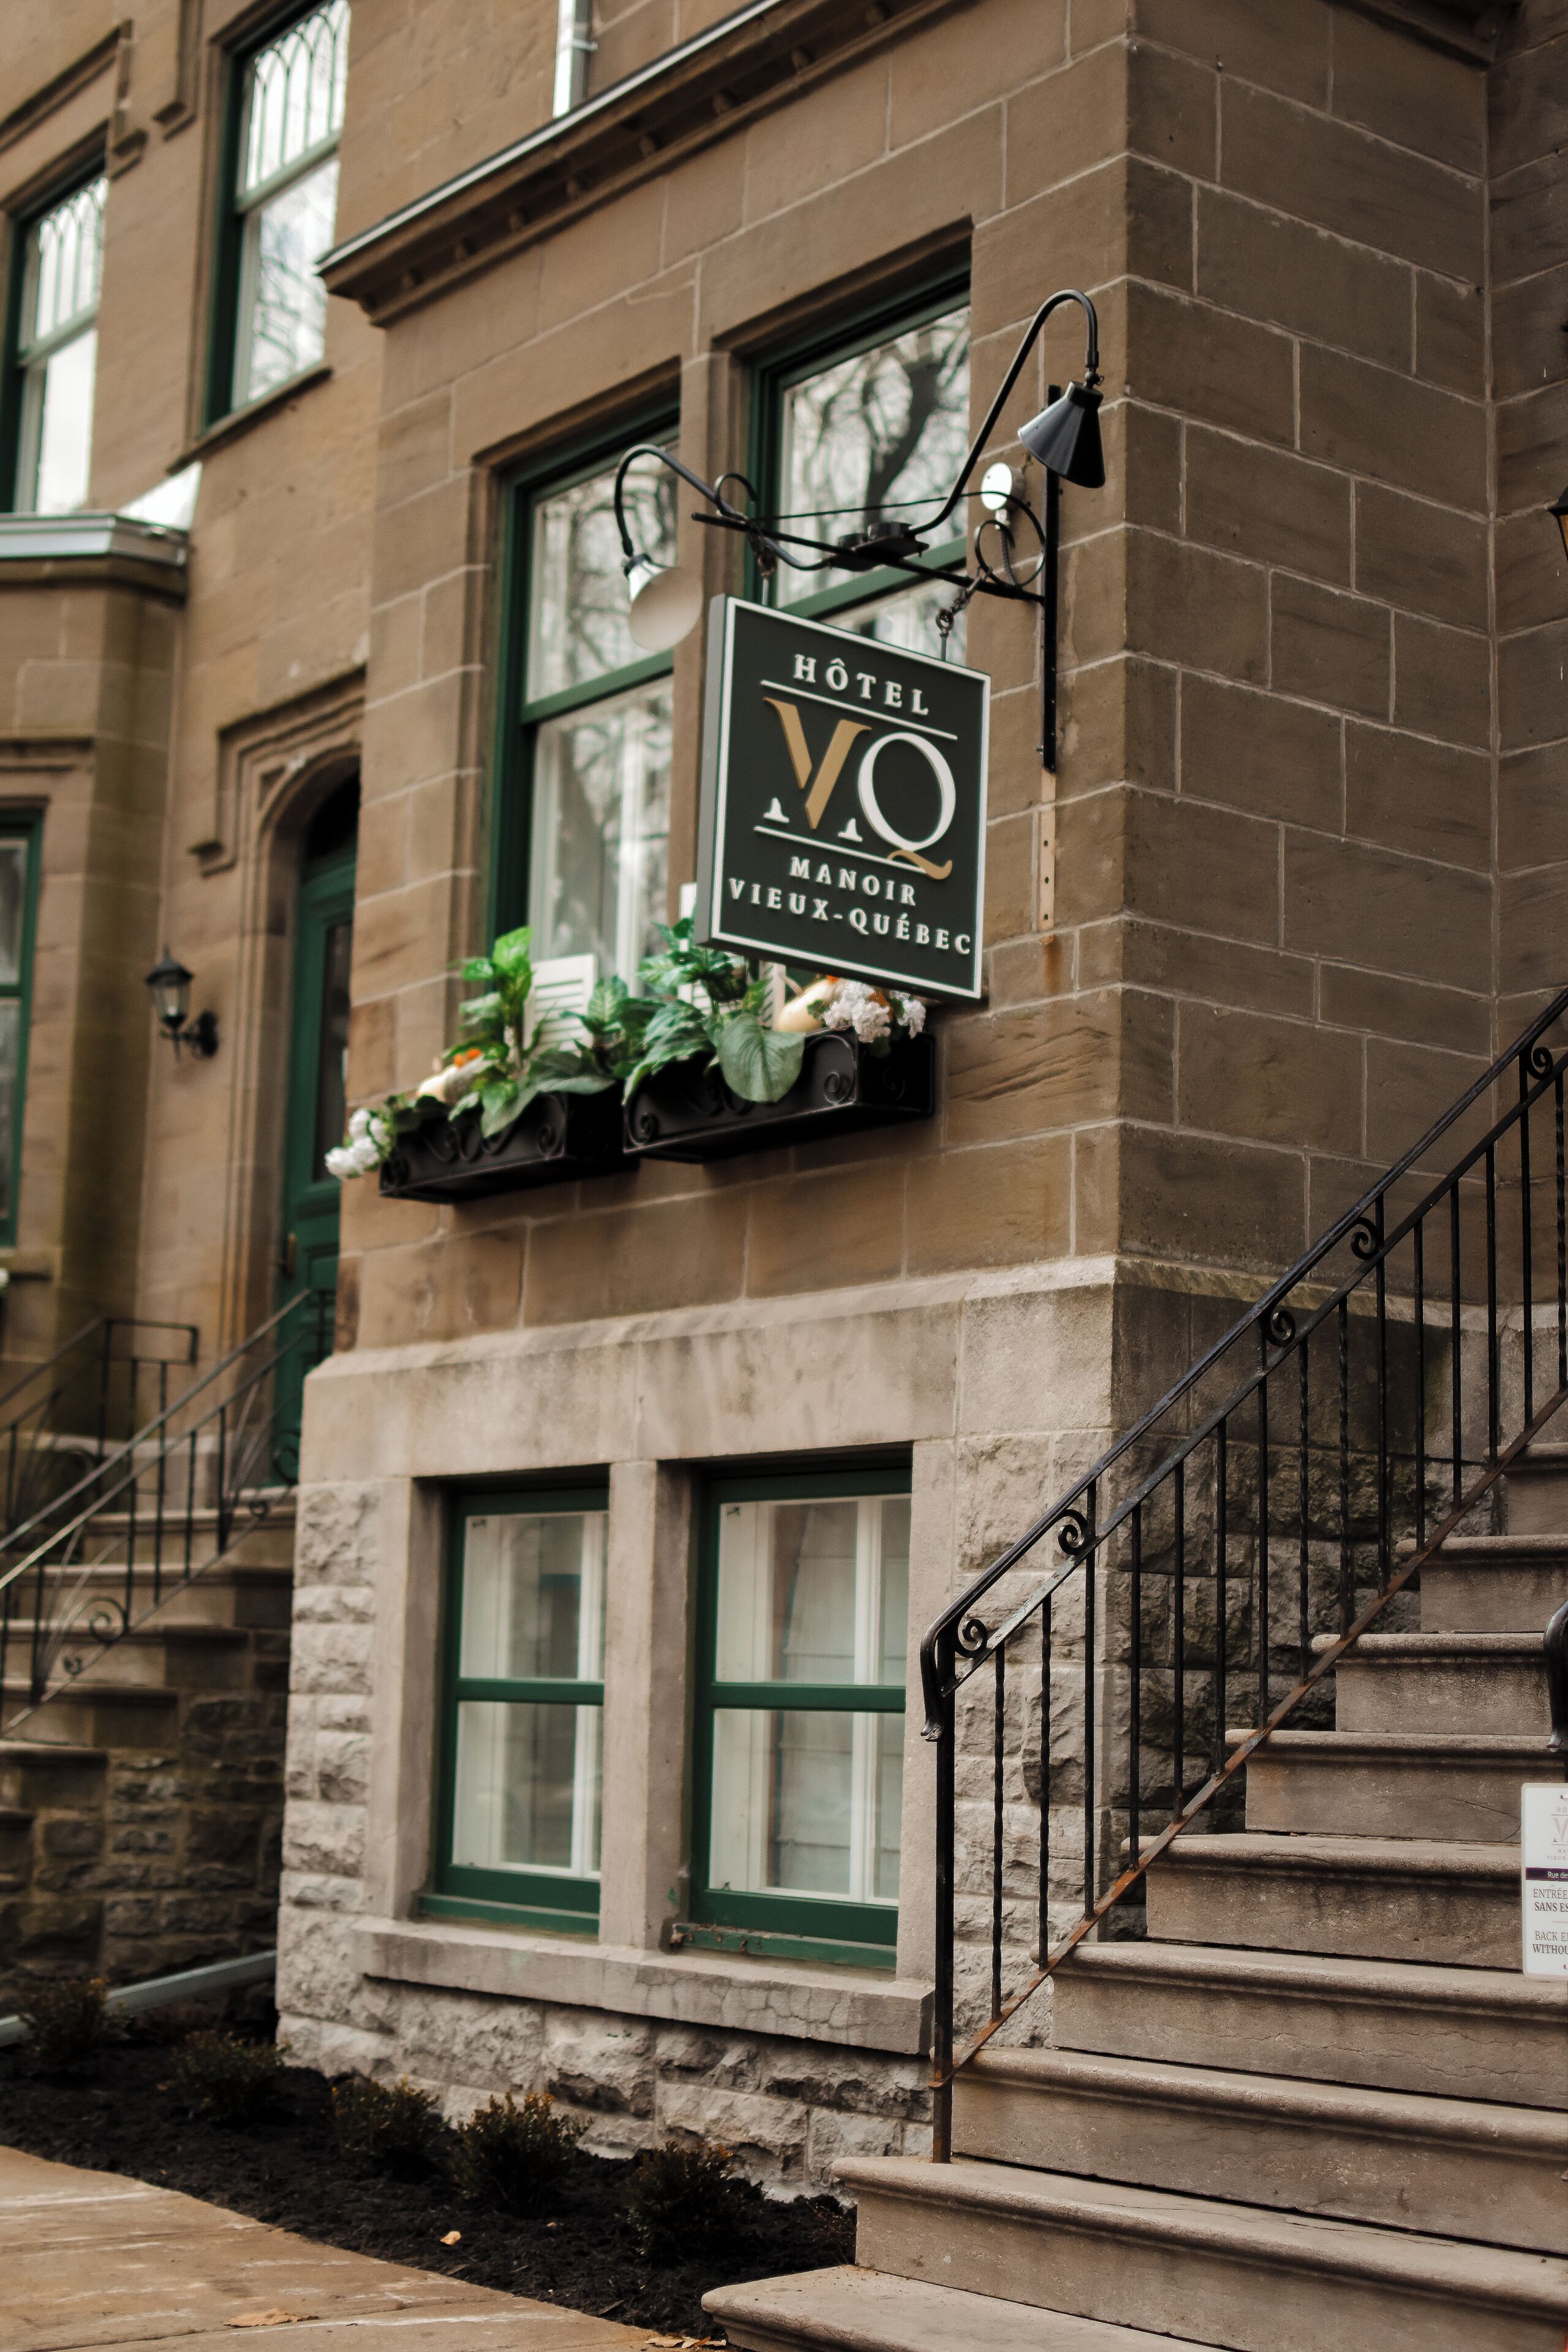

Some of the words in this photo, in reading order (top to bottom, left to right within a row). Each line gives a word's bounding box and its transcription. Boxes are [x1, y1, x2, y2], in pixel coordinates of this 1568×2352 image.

[793, 653, 929, 716] HÔTEL
[789, 856, 916, 907] MANOIR
[728, 877, 971, 956] VIEUX-QUÉBEC
[1533, 1887, 1568, 1899] ENTRÉE
[1534, 1901, 1558, 1912] SANS
[1534, 1931, 1558, 1942] BACK
